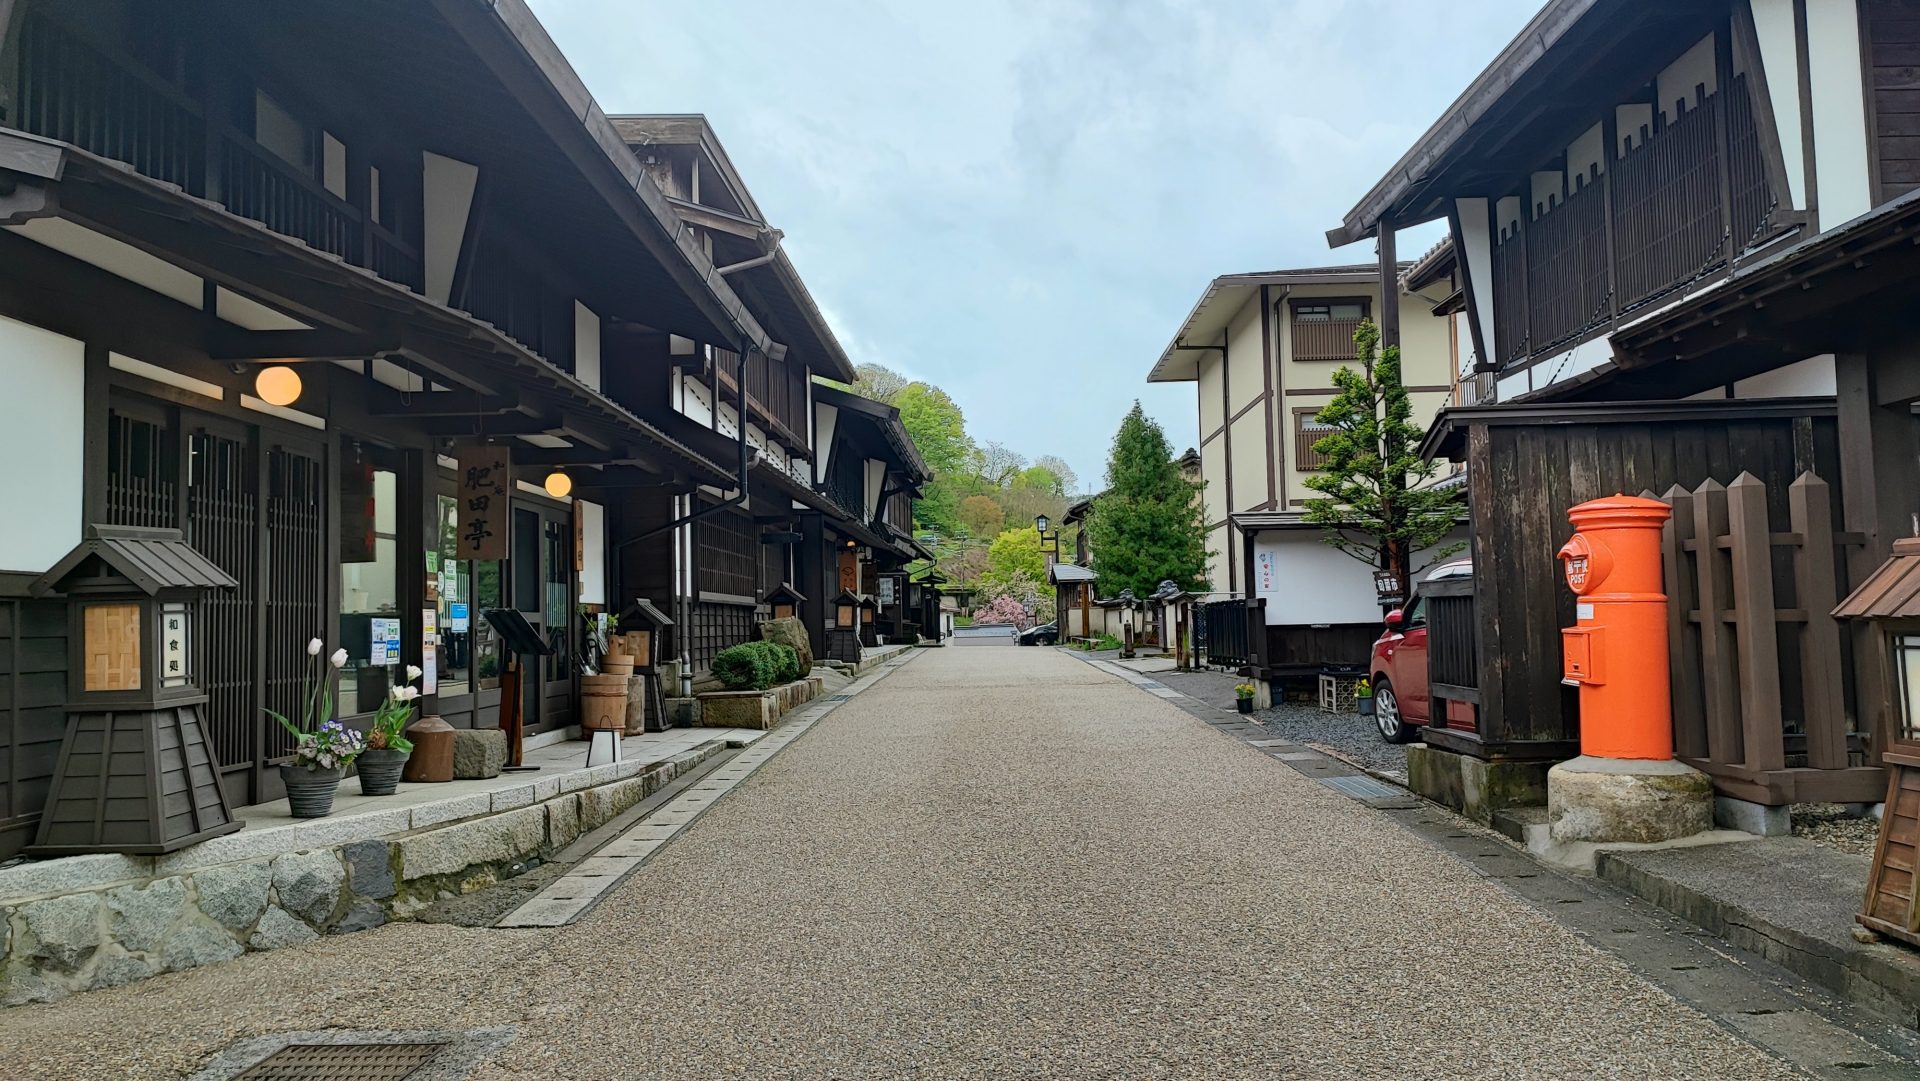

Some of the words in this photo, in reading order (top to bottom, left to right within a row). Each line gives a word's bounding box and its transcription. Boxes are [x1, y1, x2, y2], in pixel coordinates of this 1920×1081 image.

[464, 466, 495, 551] 肥田亭
[1570, 573, 1585, 584] POST
[169, 618, 179, 672] 和食処
